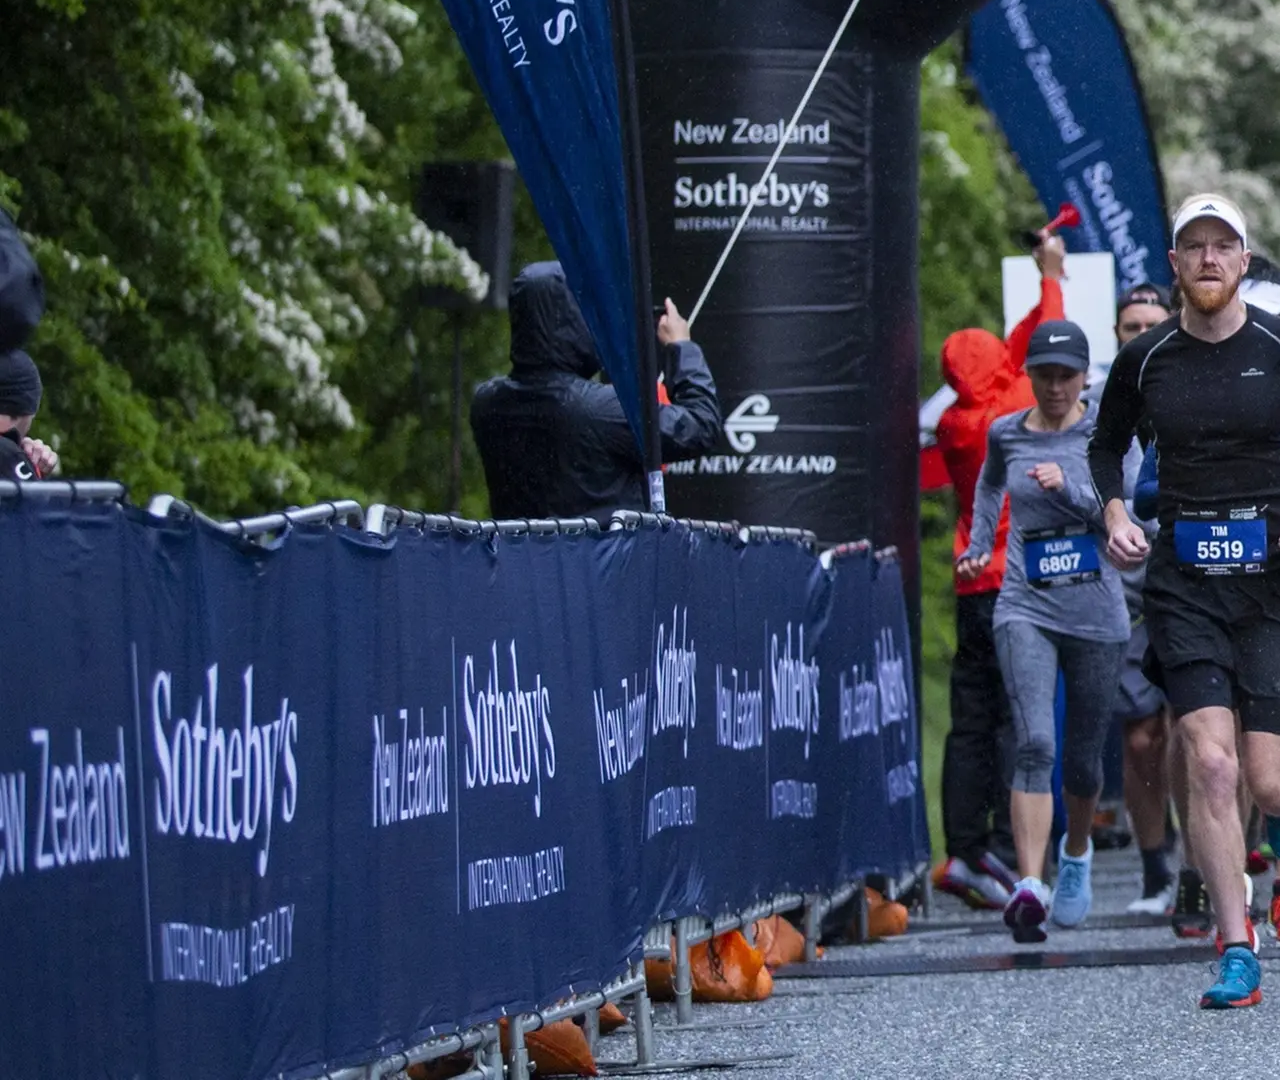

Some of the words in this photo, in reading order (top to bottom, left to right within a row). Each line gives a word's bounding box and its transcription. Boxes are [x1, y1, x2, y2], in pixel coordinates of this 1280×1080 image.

[674, 120, 726, 145] New
[732, 118, 830, 145] Zealand
[674, 172, 830, 214] Sotheby's
[674, 216, 777, 232] INTERNATONAL
[1083, 161, 1150, 294] Sotheby
[700, 455, 745, 474] NEW
[745, 454, 837, 475] ZEALAND
[1197, 540, 1244, 560] 5519
[1210, 525, 1228, 537] TIM
[1039, 552, 1081, 575] 6807
[464, 638, 557, 819] Sotheby's
[150, 661, 298, 879] Sotheby's
[374, 713, 400, 828] New
[400, 706, 449, 821] Zealand
[31, 725, 131, 870] Zealand
[250, 904, 296, 976] REALTY
